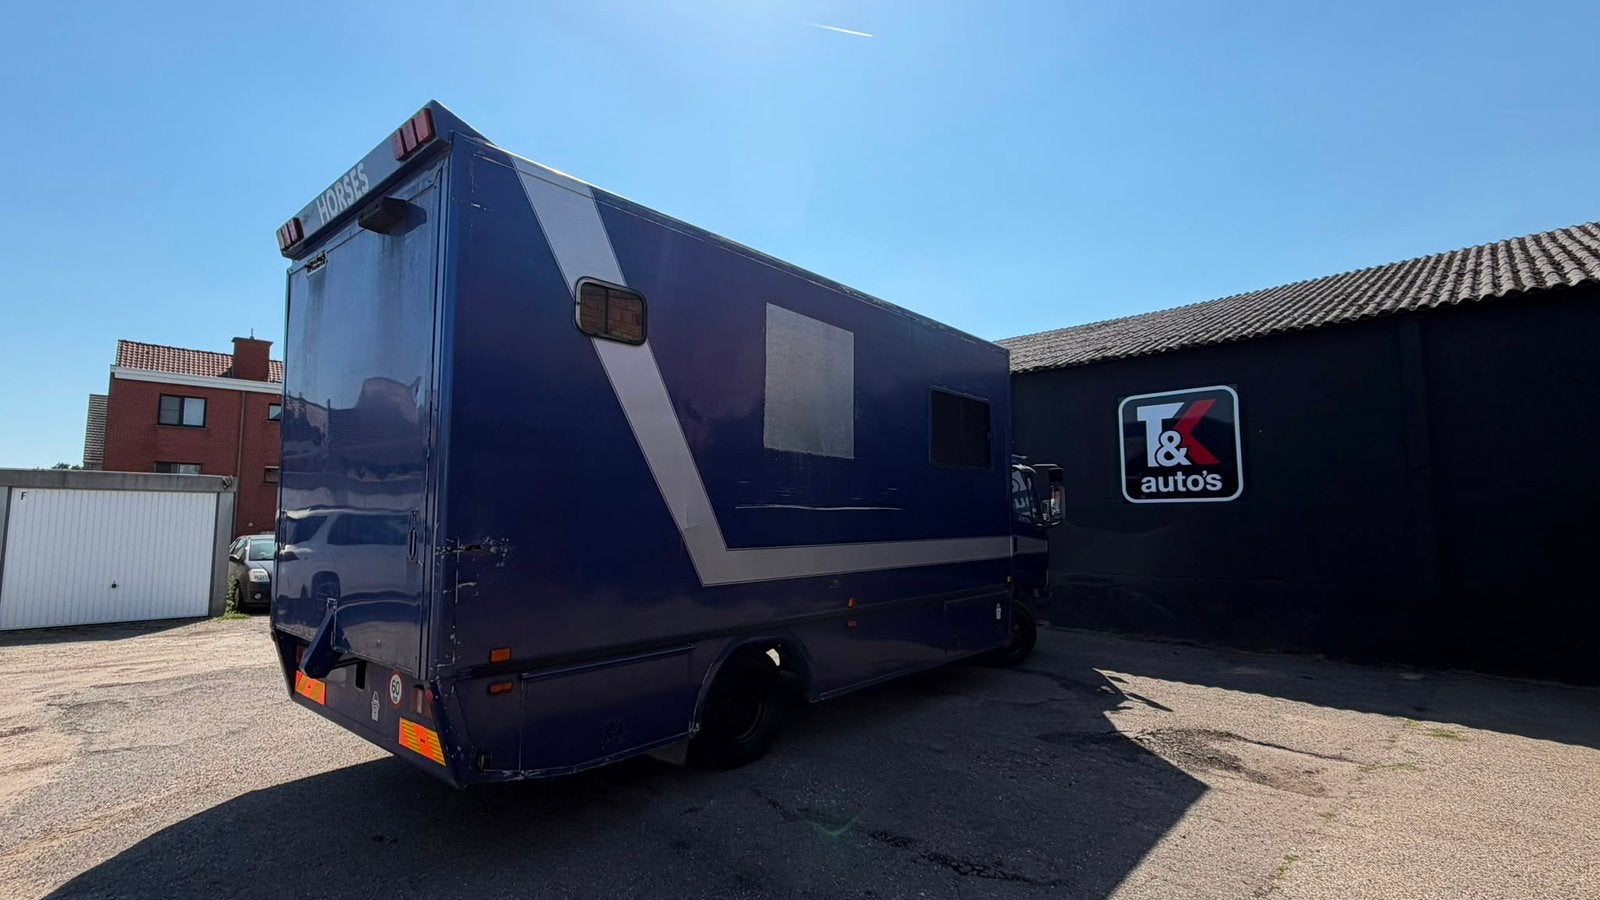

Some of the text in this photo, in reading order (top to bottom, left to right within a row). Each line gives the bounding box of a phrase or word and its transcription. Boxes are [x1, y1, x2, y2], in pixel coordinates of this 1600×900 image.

[316, 162, 370, 226] HORSES
[1136, 398, 1222, 468] T&K
[1140, 470, 1223, 493] auto's
[20, 491, 28, 500] F
[391, 679, 401, 696] 60
